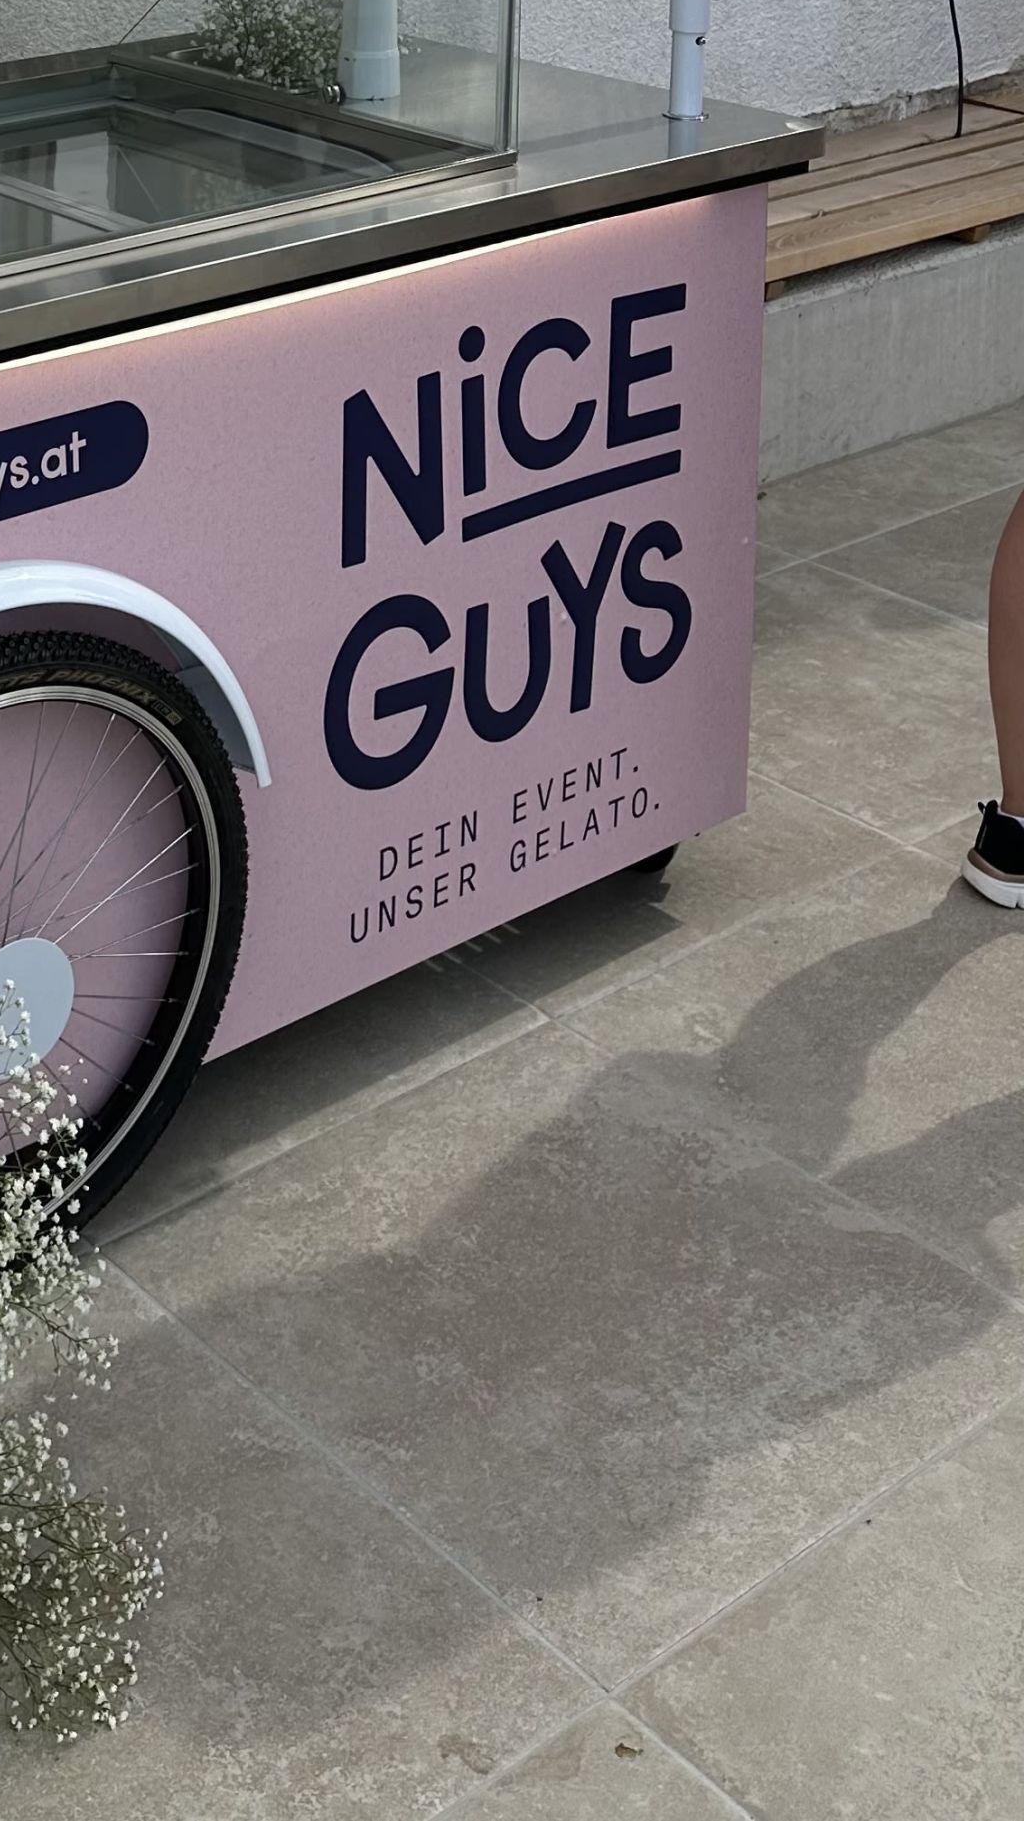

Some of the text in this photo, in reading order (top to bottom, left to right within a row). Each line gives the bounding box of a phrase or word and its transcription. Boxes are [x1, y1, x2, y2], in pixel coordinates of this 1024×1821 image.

[323, 520, 692, 791] GUYS
[350, 787, 661, 944] UNSER GELATO.
[378, 746, 640, 882] DEIN EVENT.
